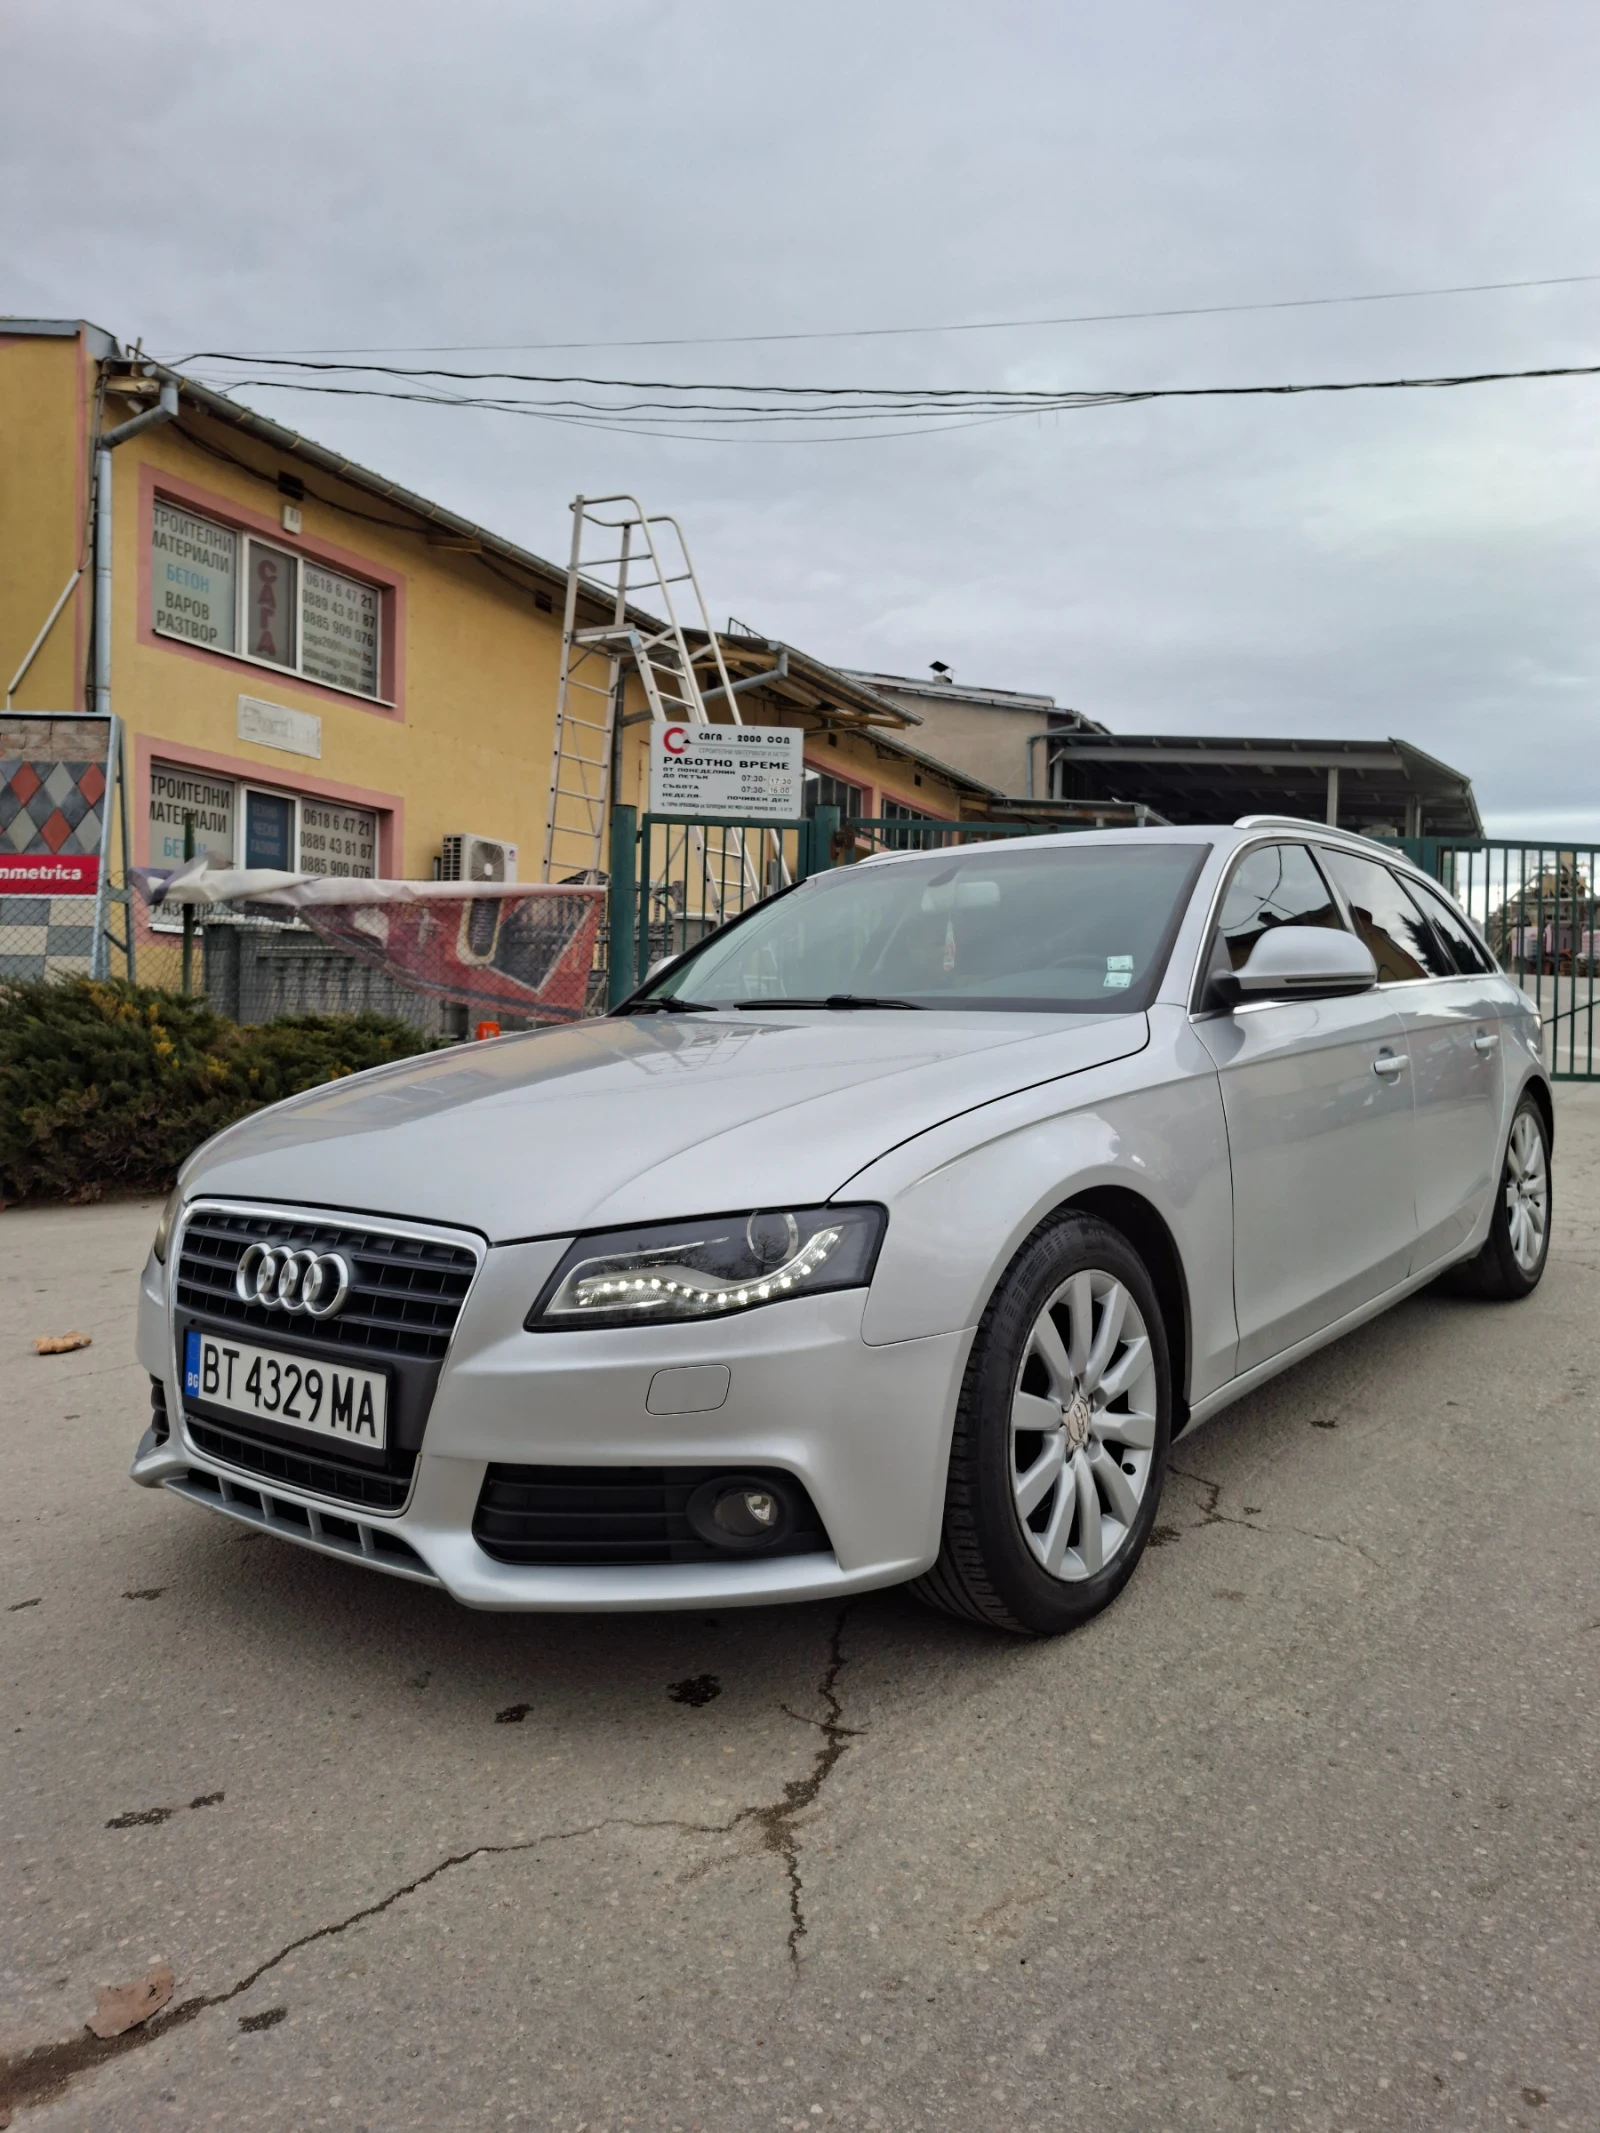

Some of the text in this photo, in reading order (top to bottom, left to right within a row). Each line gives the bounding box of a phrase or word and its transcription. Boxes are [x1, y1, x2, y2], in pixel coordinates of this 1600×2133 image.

[166, 564, 209, 593] БЕТОН
[306, 572, 372, 609] 0618 6 47 21
[166, 591, 209, 620] ВАРОВ
[256, 560, 277, 656] САГА
[302, 590, 375, 628] 0889 43 81 87
[157, 610, 217, 643] РАЗТВОР
[303, 609, 373, 647] 0885 909 076
[698, 732, 723, 741] САГА
[737, 734, 762, 743] 2000
[767, 736, 790, 744] ООД
[663, 756, 790, 770] РАБОТНО ВРЕМЕ
[304, 808, 370, 836] 0618 6 47 21
[300, 831, 373, 860] 0889 43 81 87
[301, 855, 371, 879] 0885 909 076
[187, 1372, 199, 1388] BG
[202, 1343, 376, 1438] BT 4329 MA
